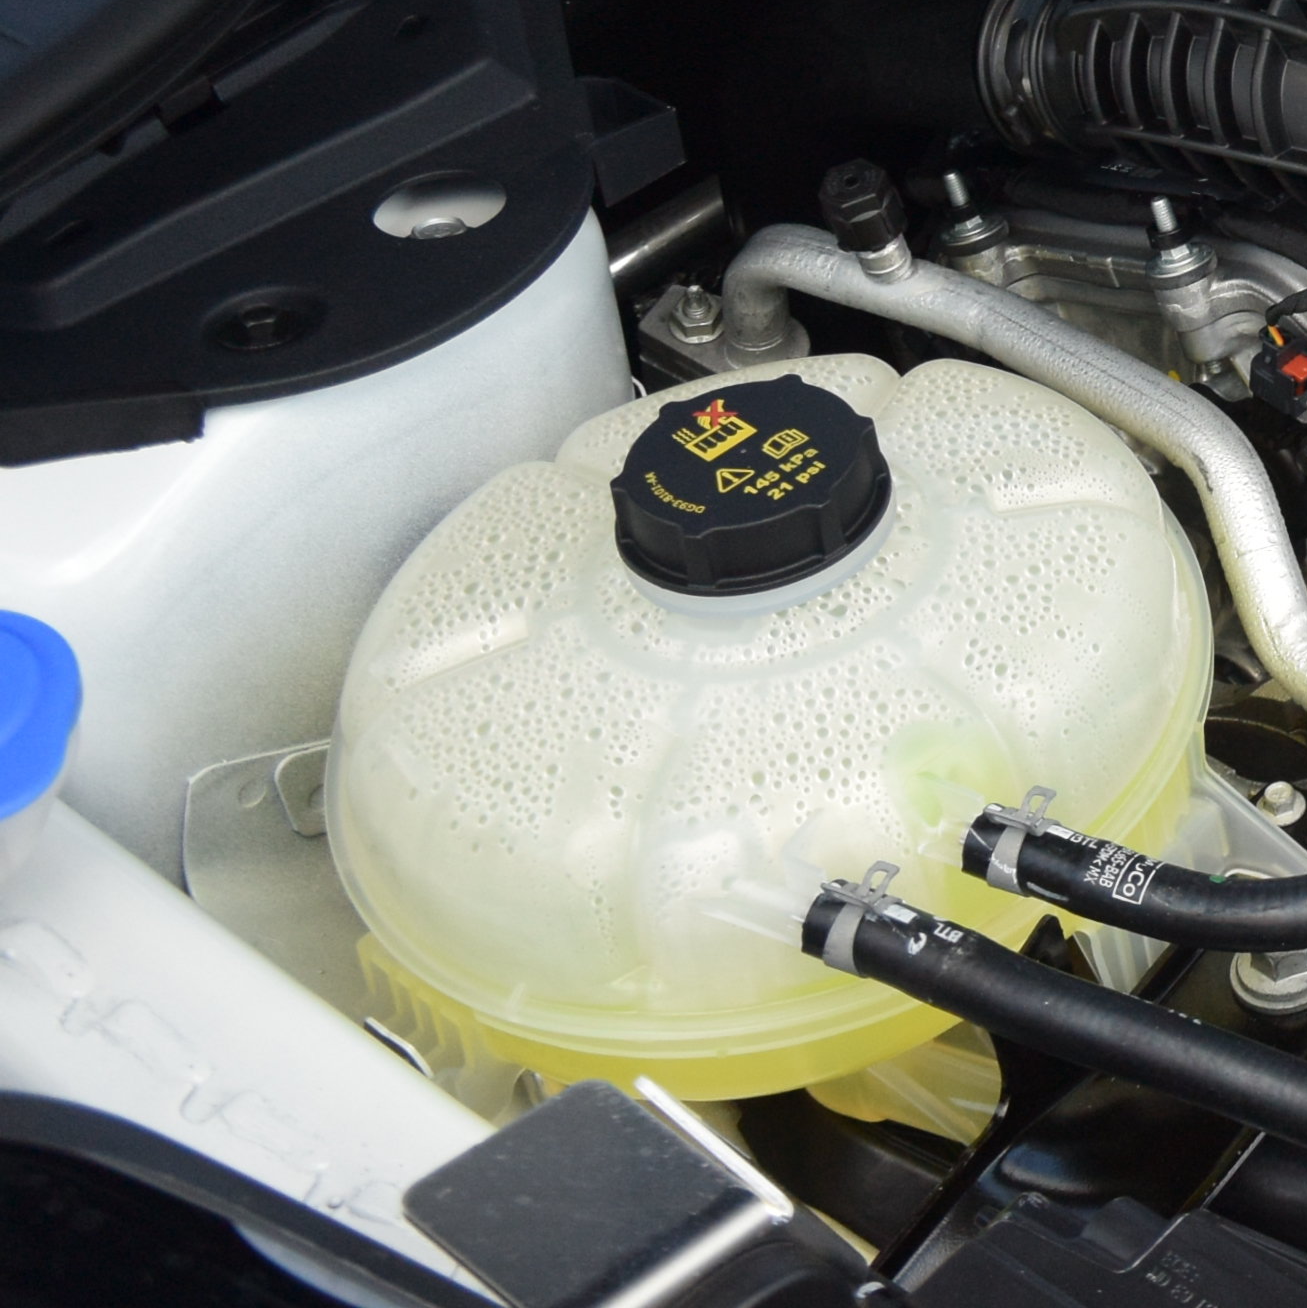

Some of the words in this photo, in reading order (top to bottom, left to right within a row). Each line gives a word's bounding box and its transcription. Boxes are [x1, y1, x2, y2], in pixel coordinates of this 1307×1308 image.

[743, 471, 780, 495] 145
[782, 448, 820, 473] kPa
[767, 483, 792, 501] 21
[795, 461, 826, 487] psi
[1070, 833, 1099, 849] BTL
[933, 921, 965, 944] BTL
